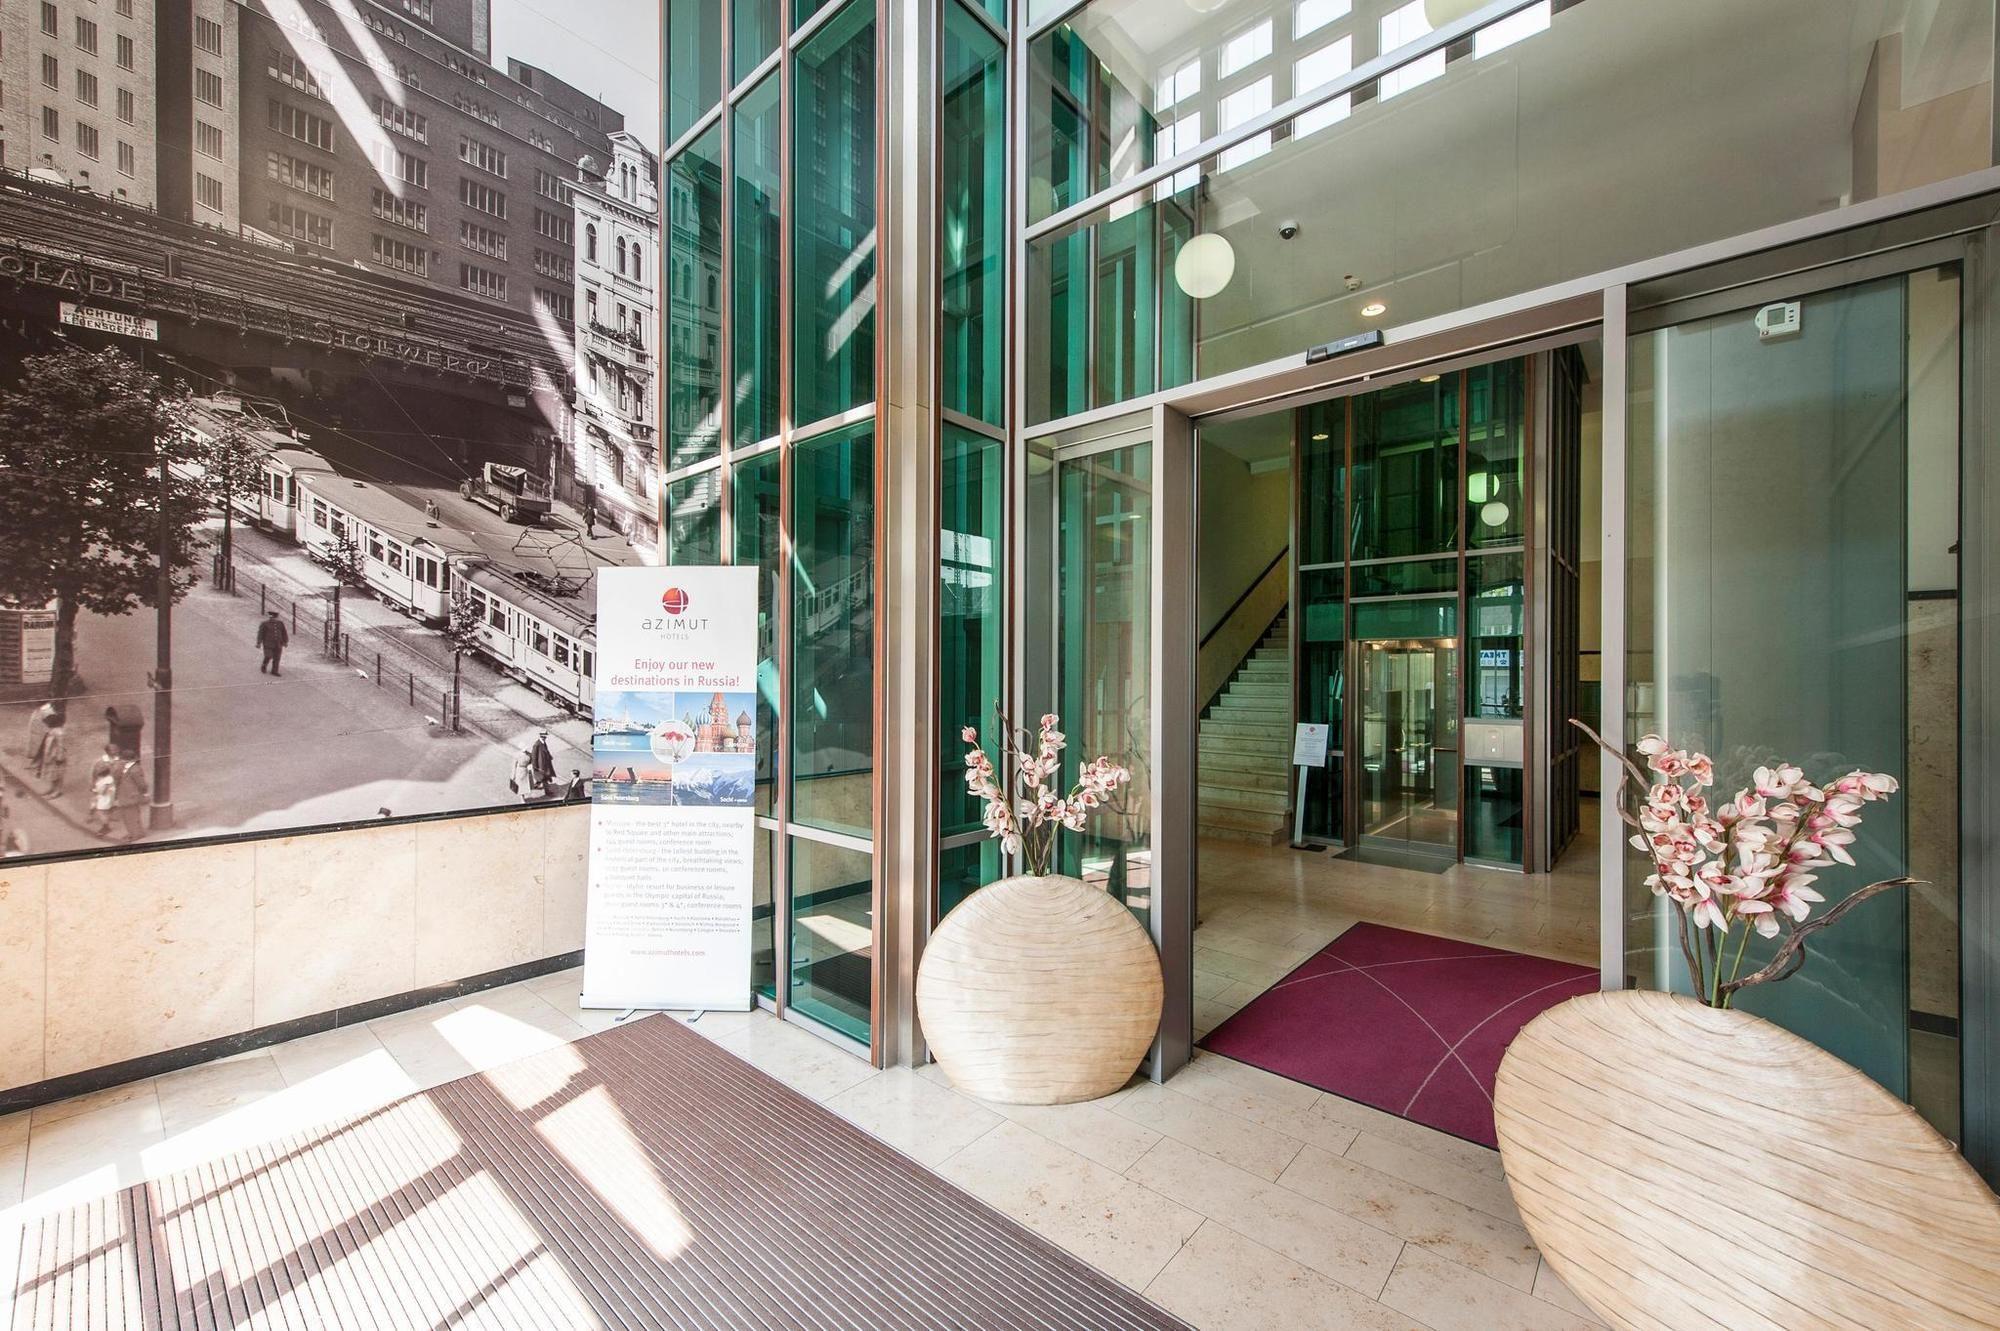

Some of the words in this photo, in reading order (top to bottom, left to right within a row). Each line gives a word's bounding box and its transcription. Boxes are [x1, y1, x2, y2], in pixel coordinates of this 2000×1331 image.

[660, 633, 690, 641] HOTELS
[634, 658, 665, 672] Enjoy
[668, 660, 688, 671] our
[691, 660, 715, 671] new
[610, 675, 680, 687] destinations
[683, 675, 695, 687] in
[698, 676, 740, 687] Russia!
